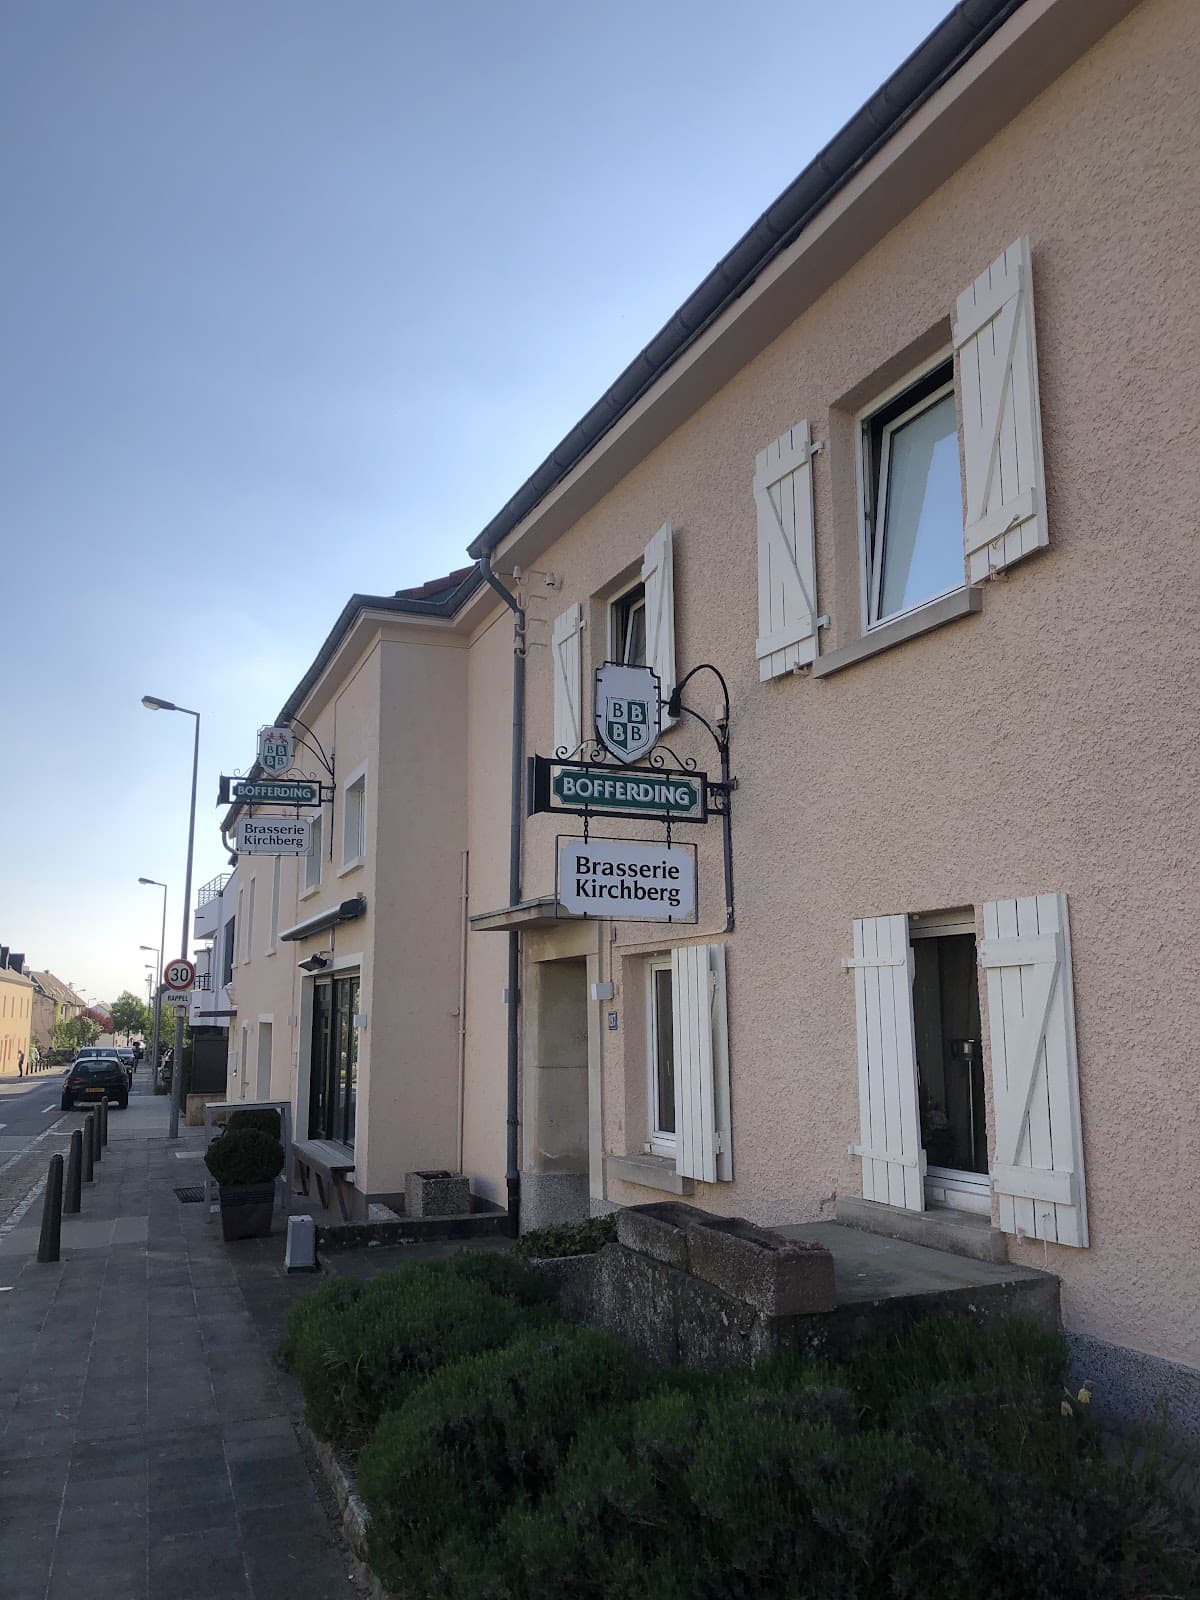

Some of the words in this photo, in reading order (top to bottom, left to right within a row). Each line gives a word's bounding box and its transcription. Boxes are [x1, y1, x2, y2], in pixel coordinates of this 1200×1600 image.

[613, 703, 623, 718] B
[631, 704, 642, 721] B
[613, 723, 624, 741] B
[631, 726, 641, 741] B
[237, 785, 311, 798] BOFFERDING
[563, 777, 690, 806] BOFFERDING
[245, 823, 305, 835] Brasserie
[244, 835, 304, 848] Kirchberg
[575, 855, 681, 880] Brasserie
[575, 878, 681, 907] Kirchberg
[170, 967, 189, 982] 30
